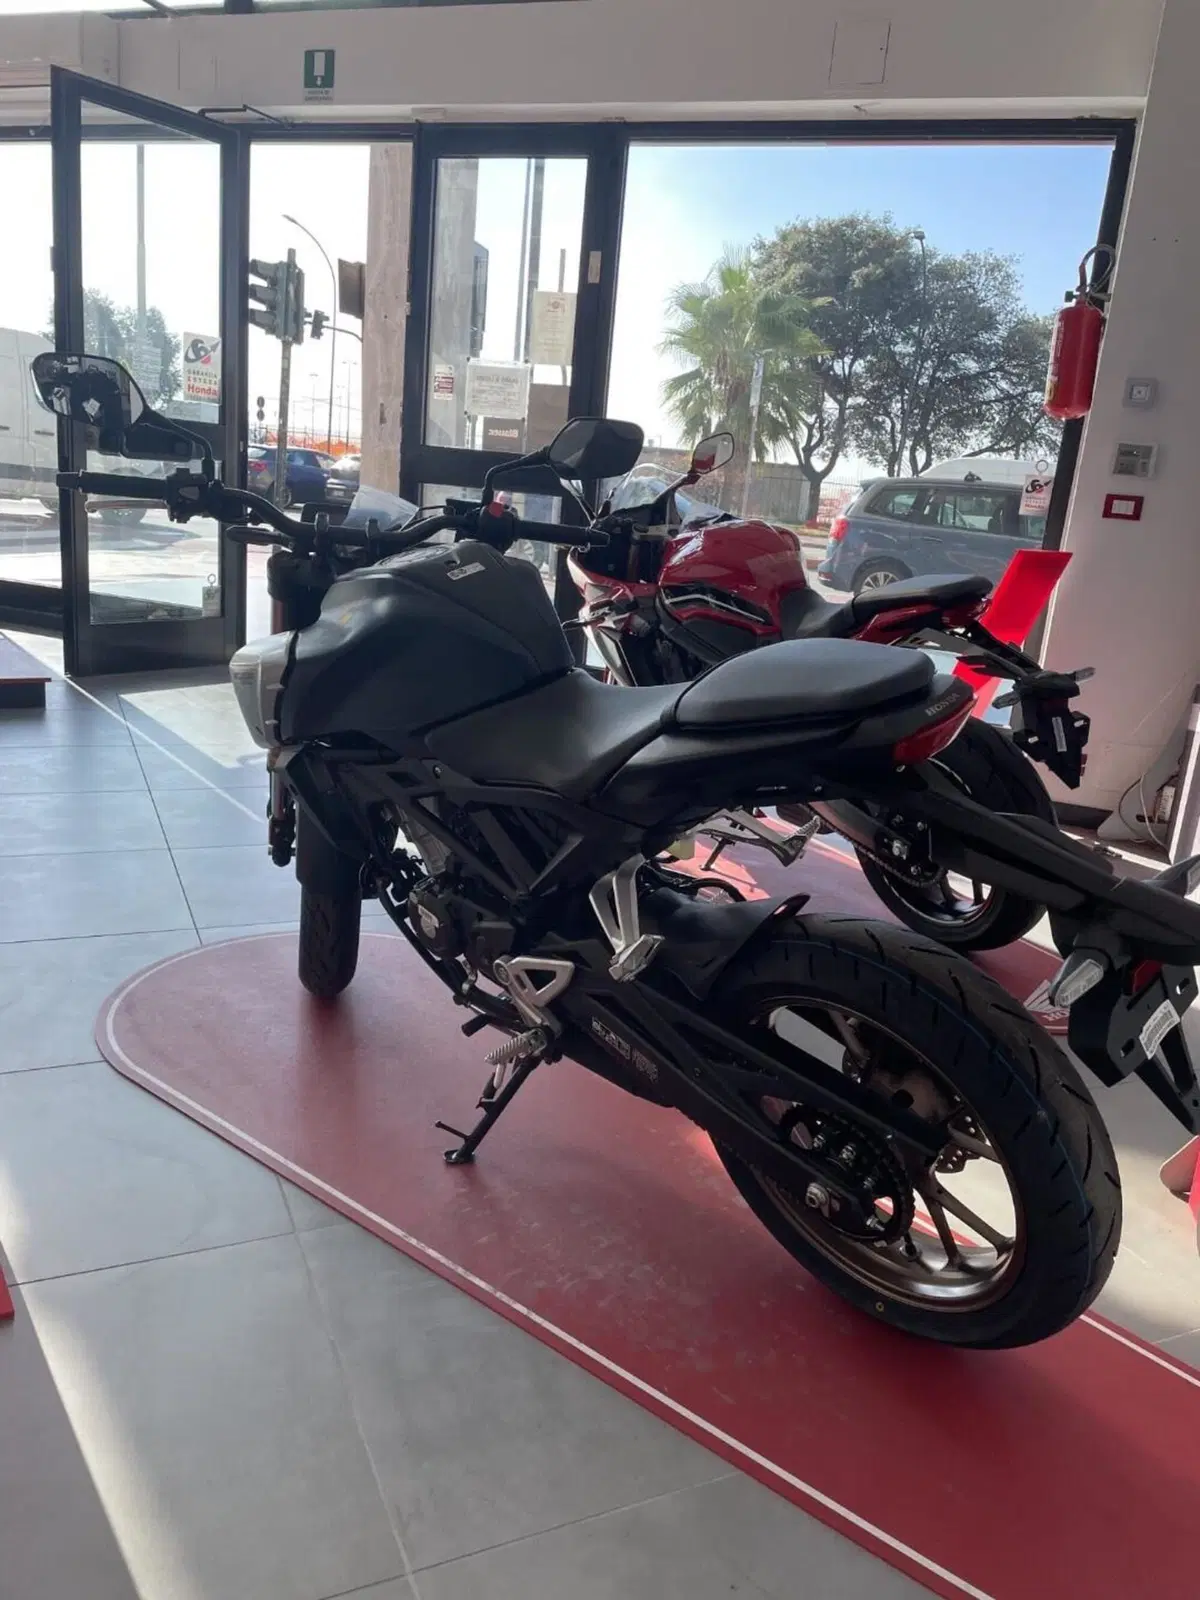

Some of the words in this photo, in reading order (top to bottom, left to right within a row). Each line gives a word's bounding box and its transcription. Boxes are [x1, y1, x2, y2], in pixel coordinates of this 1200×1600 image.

[187, 384, 218, 396] Honda
[924, 692, 961, 716] HONDA
[1041, 1008, 1070, 1022] HO
